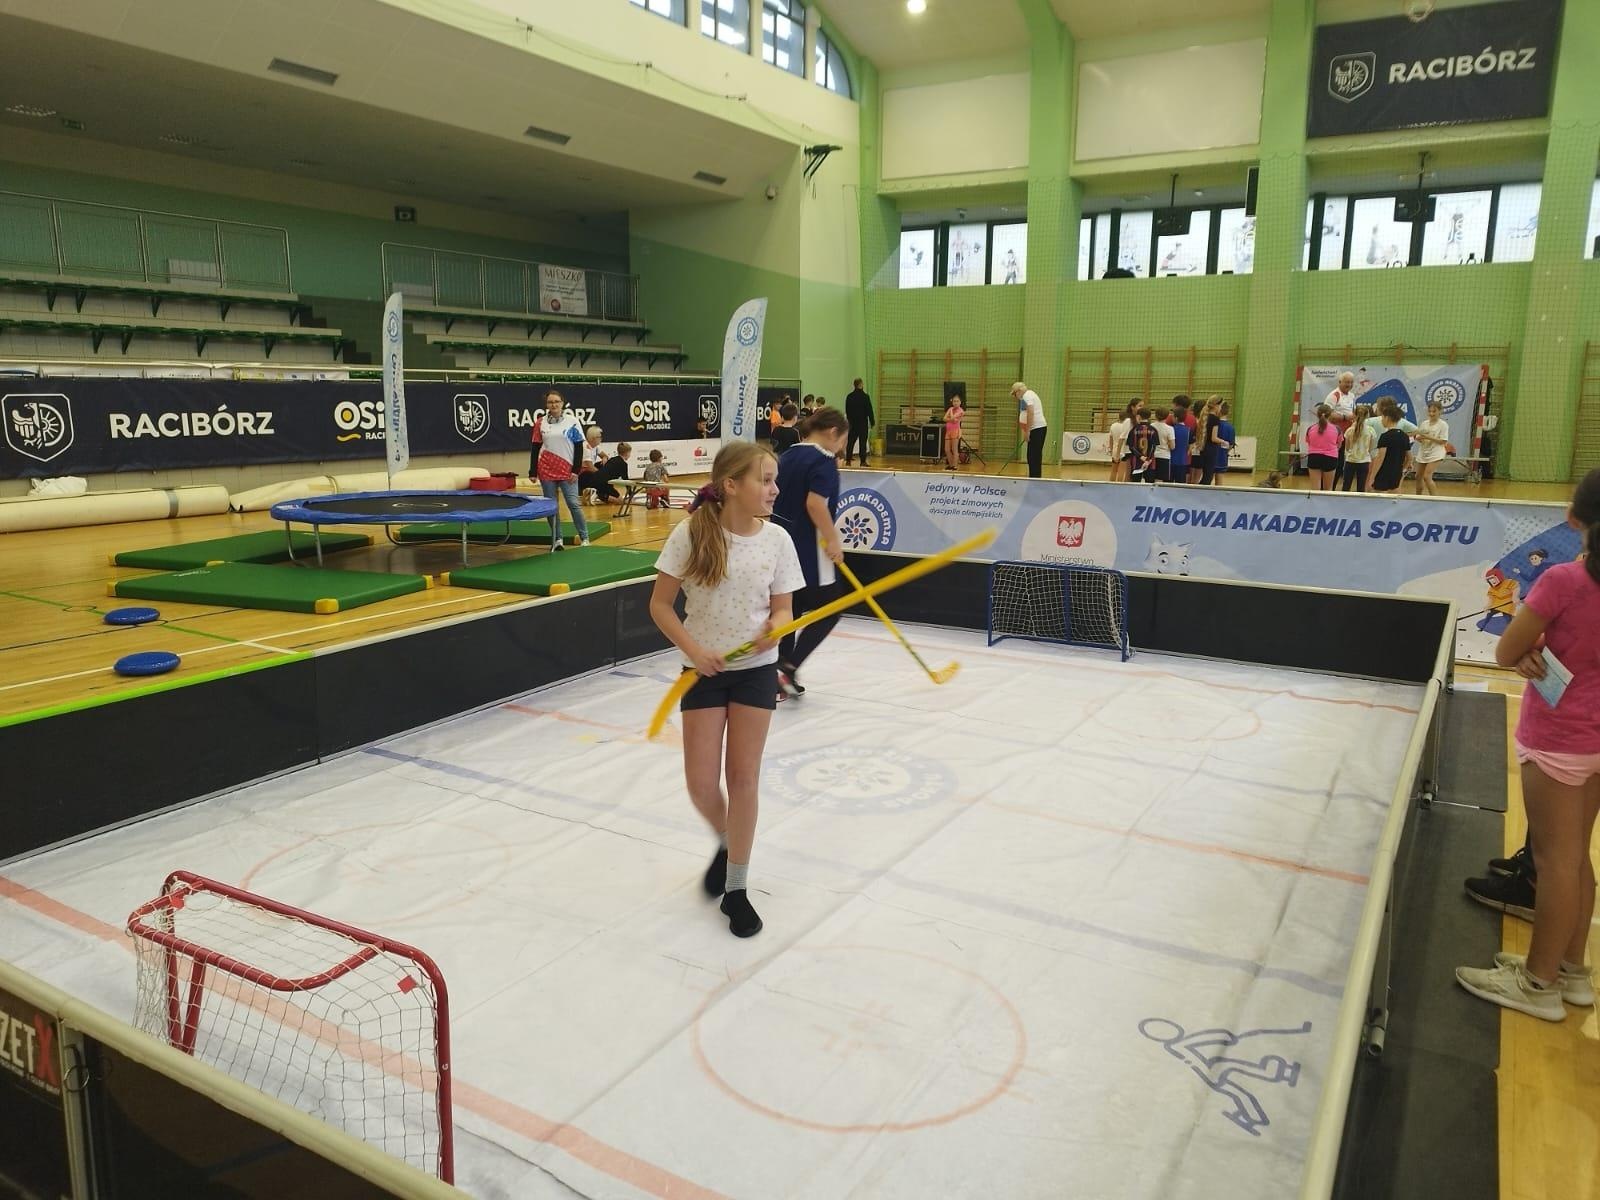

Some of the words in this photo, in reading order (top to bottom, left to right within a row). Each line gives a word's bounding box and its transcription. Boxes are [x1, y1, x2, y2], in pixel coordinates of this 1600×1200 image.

[1388, 46, 1537, 85] RACIBÓRZ
[334, 401, 385, 430] OSi
[508, 402, 597, 428] RACÓRZ
[733, 374, 748, 436] CURLING
[110, 404, 275, 439] RACIBÓRZ
[365, 432, 386, 440] RACI
[925, 482, 960, 494] jedyny
[962, 486, 971, 494] w
[973, 485, 1007, 496] Polsce
[929, 506, 961, 516] dyscyplin
[961, 510, 1003, 519] olimpijskich
[930, 497, 960, 506] projekt
[961, 498, 1004, 509] zimowych
[1131, 506, 1228, 529] ZIMOWA
[1231, 512, 1362, 538] AKADEMIA
[1367, 519, 1480, 545] SPORTU
